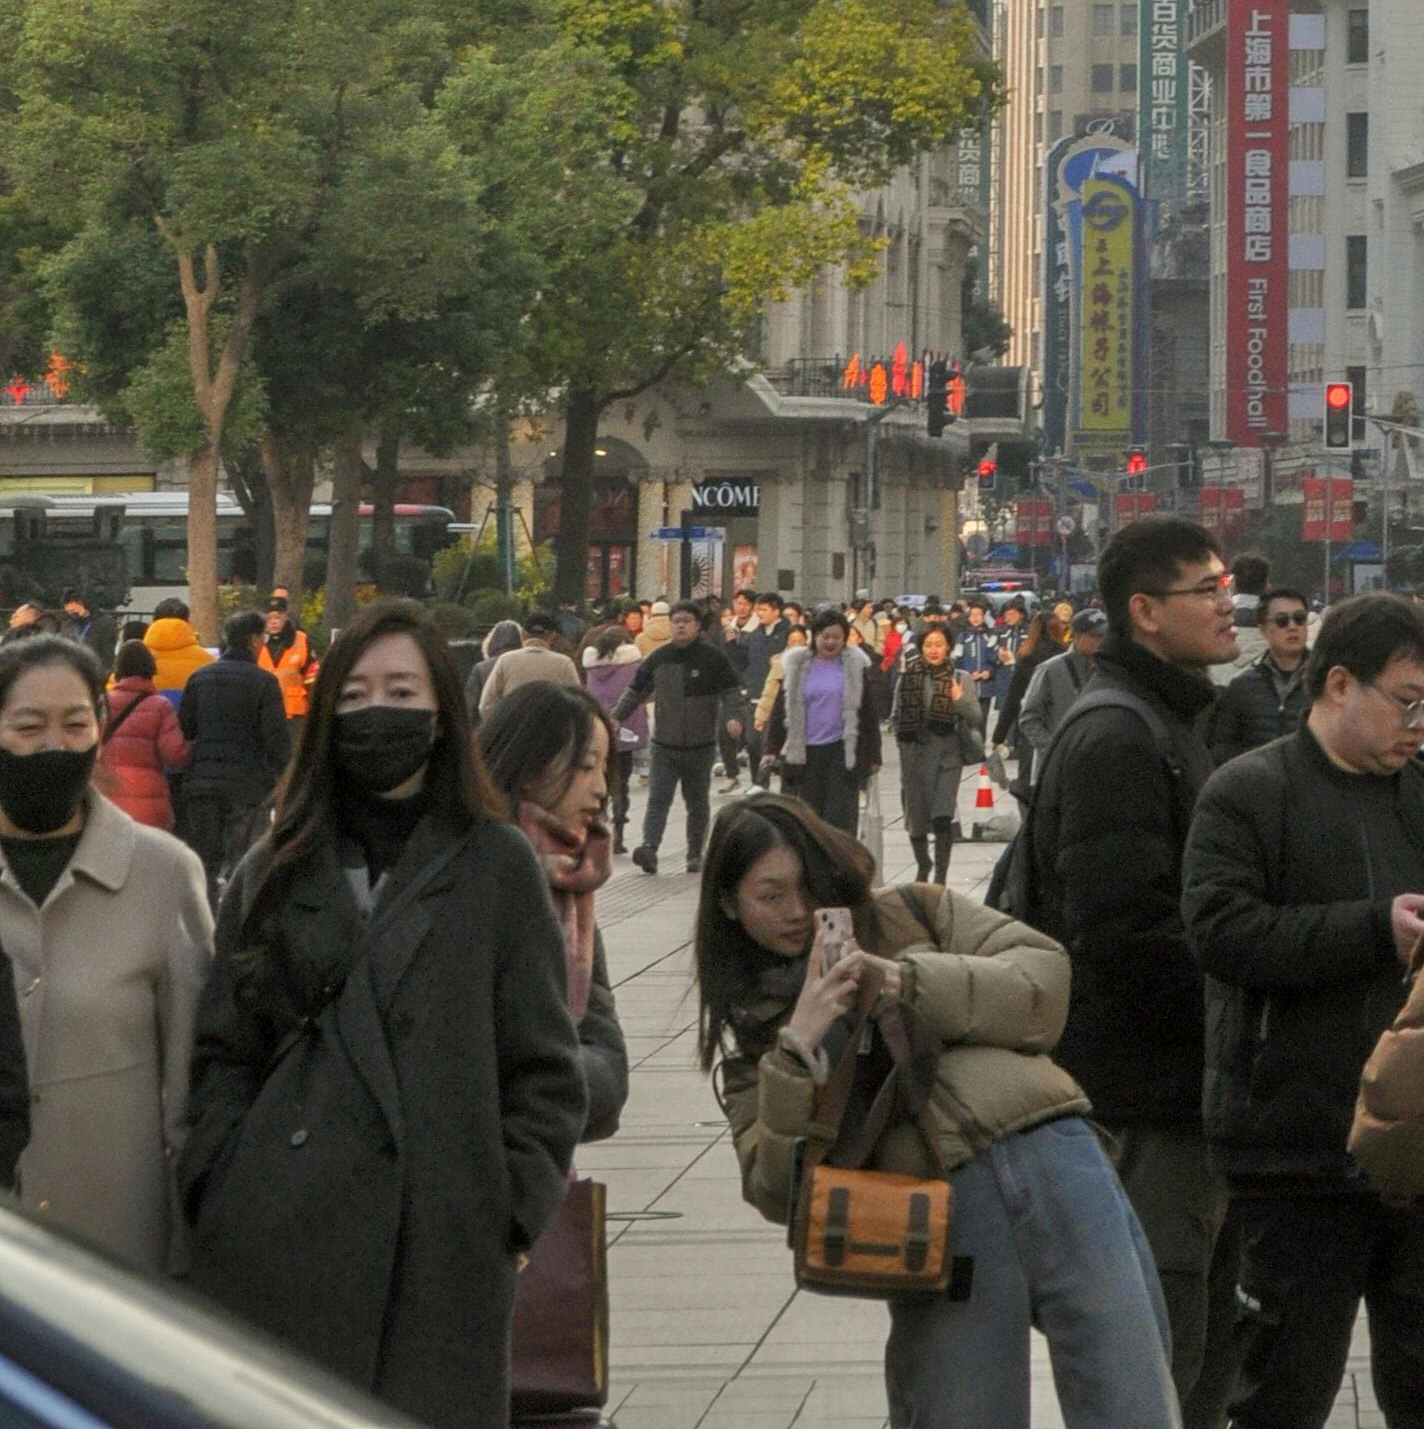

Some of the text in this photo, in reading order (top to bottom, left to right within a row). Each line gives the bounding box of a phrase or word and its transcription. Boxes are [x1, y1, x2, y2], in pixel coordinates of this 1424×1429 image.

[1245, 9, 1272, 262] 上海市第一食品商店
[1248, 278, 1267, 428] First Foodhall
